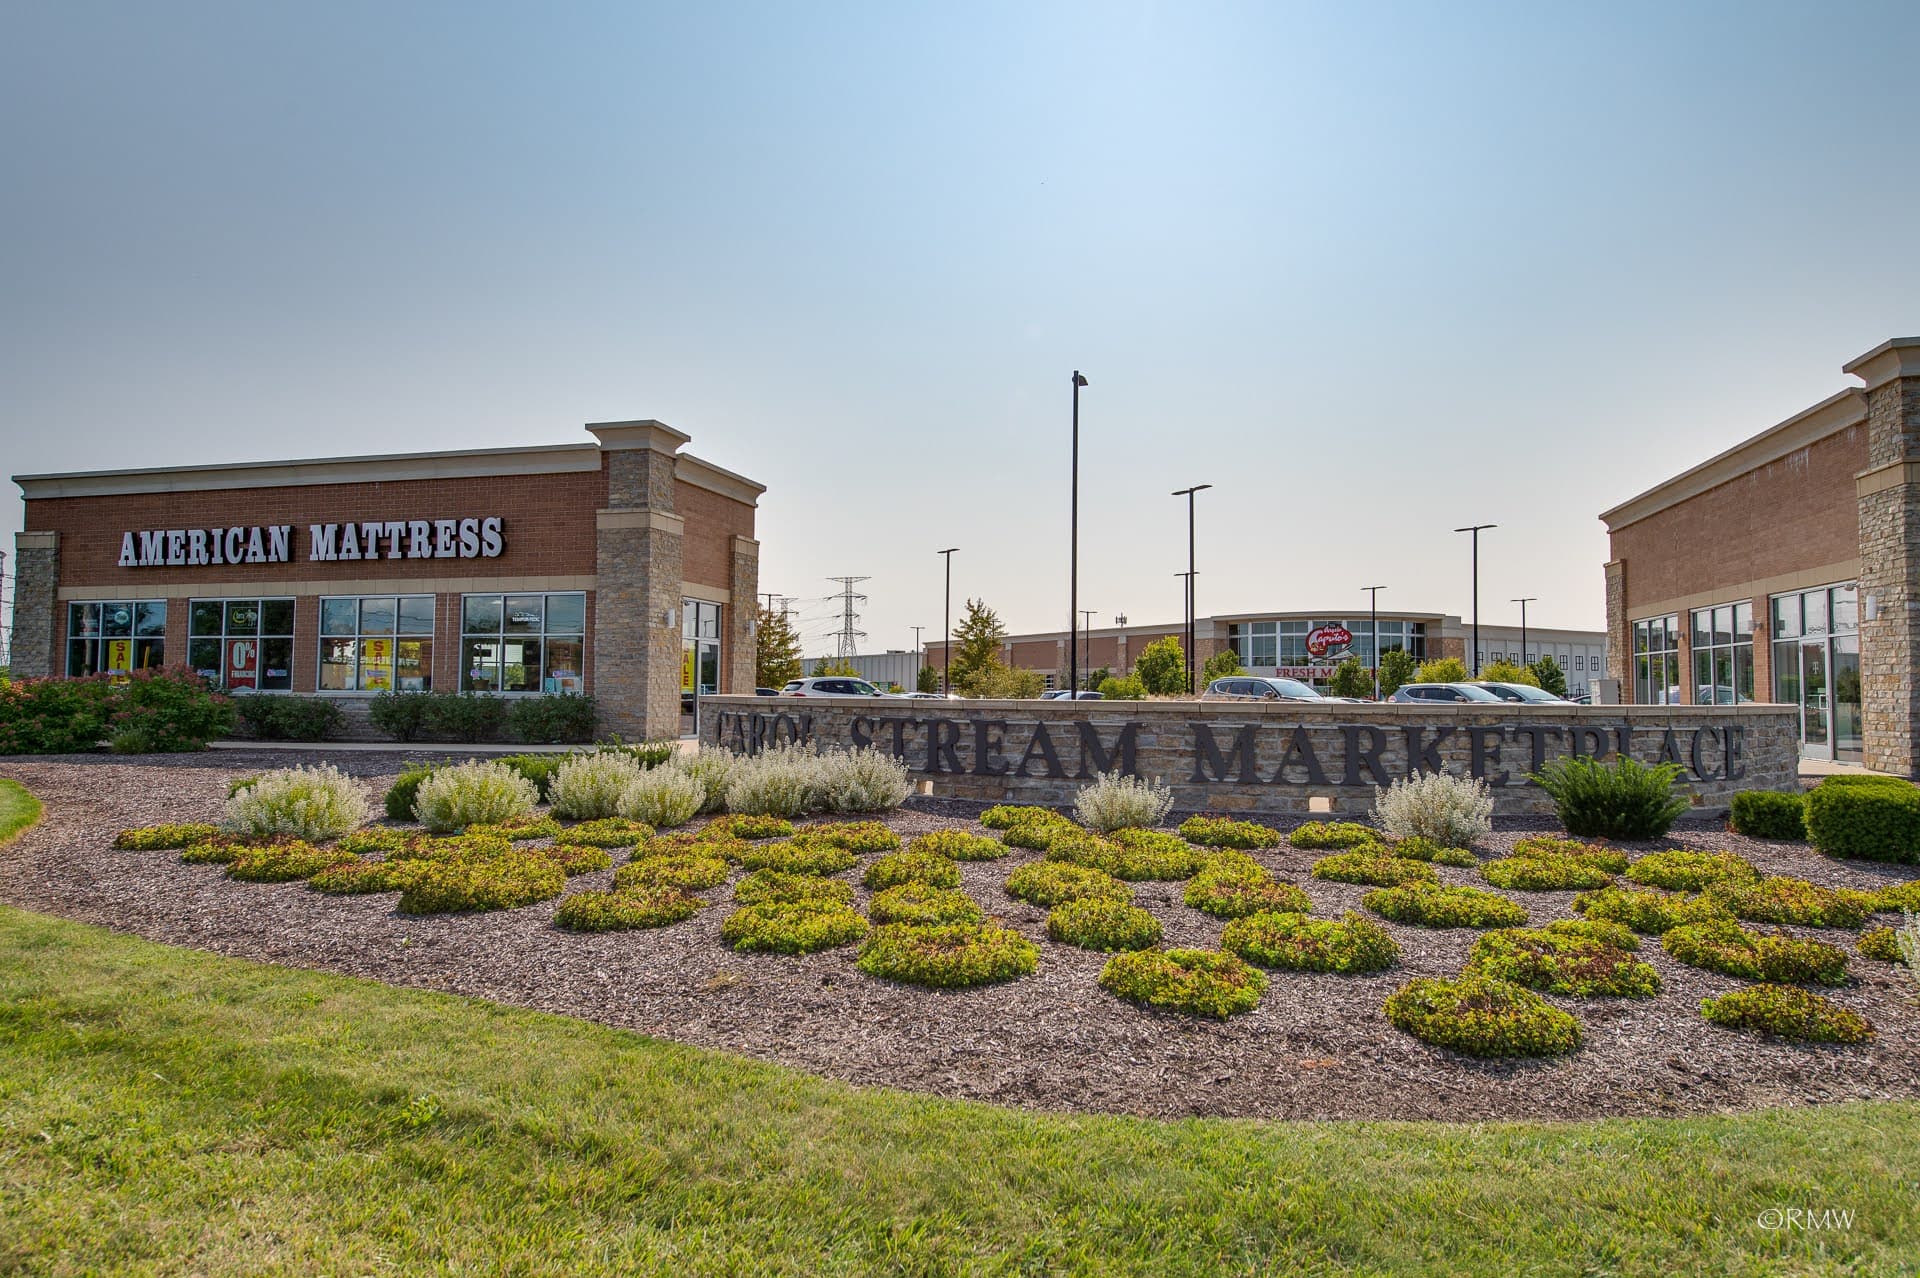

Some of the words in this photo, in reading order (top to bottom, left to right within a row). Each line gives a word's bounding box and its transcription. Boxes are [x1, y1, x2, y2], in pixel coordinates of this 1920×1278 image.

[118, 525, 291, 566] AMERICAN
[309, 517, 503, 561] MATTRESS
[232, 642, 256, 669] 0%
[1276, 668, 1316, 678] FRESH
[850, 716, 1148, 779] STREAM
